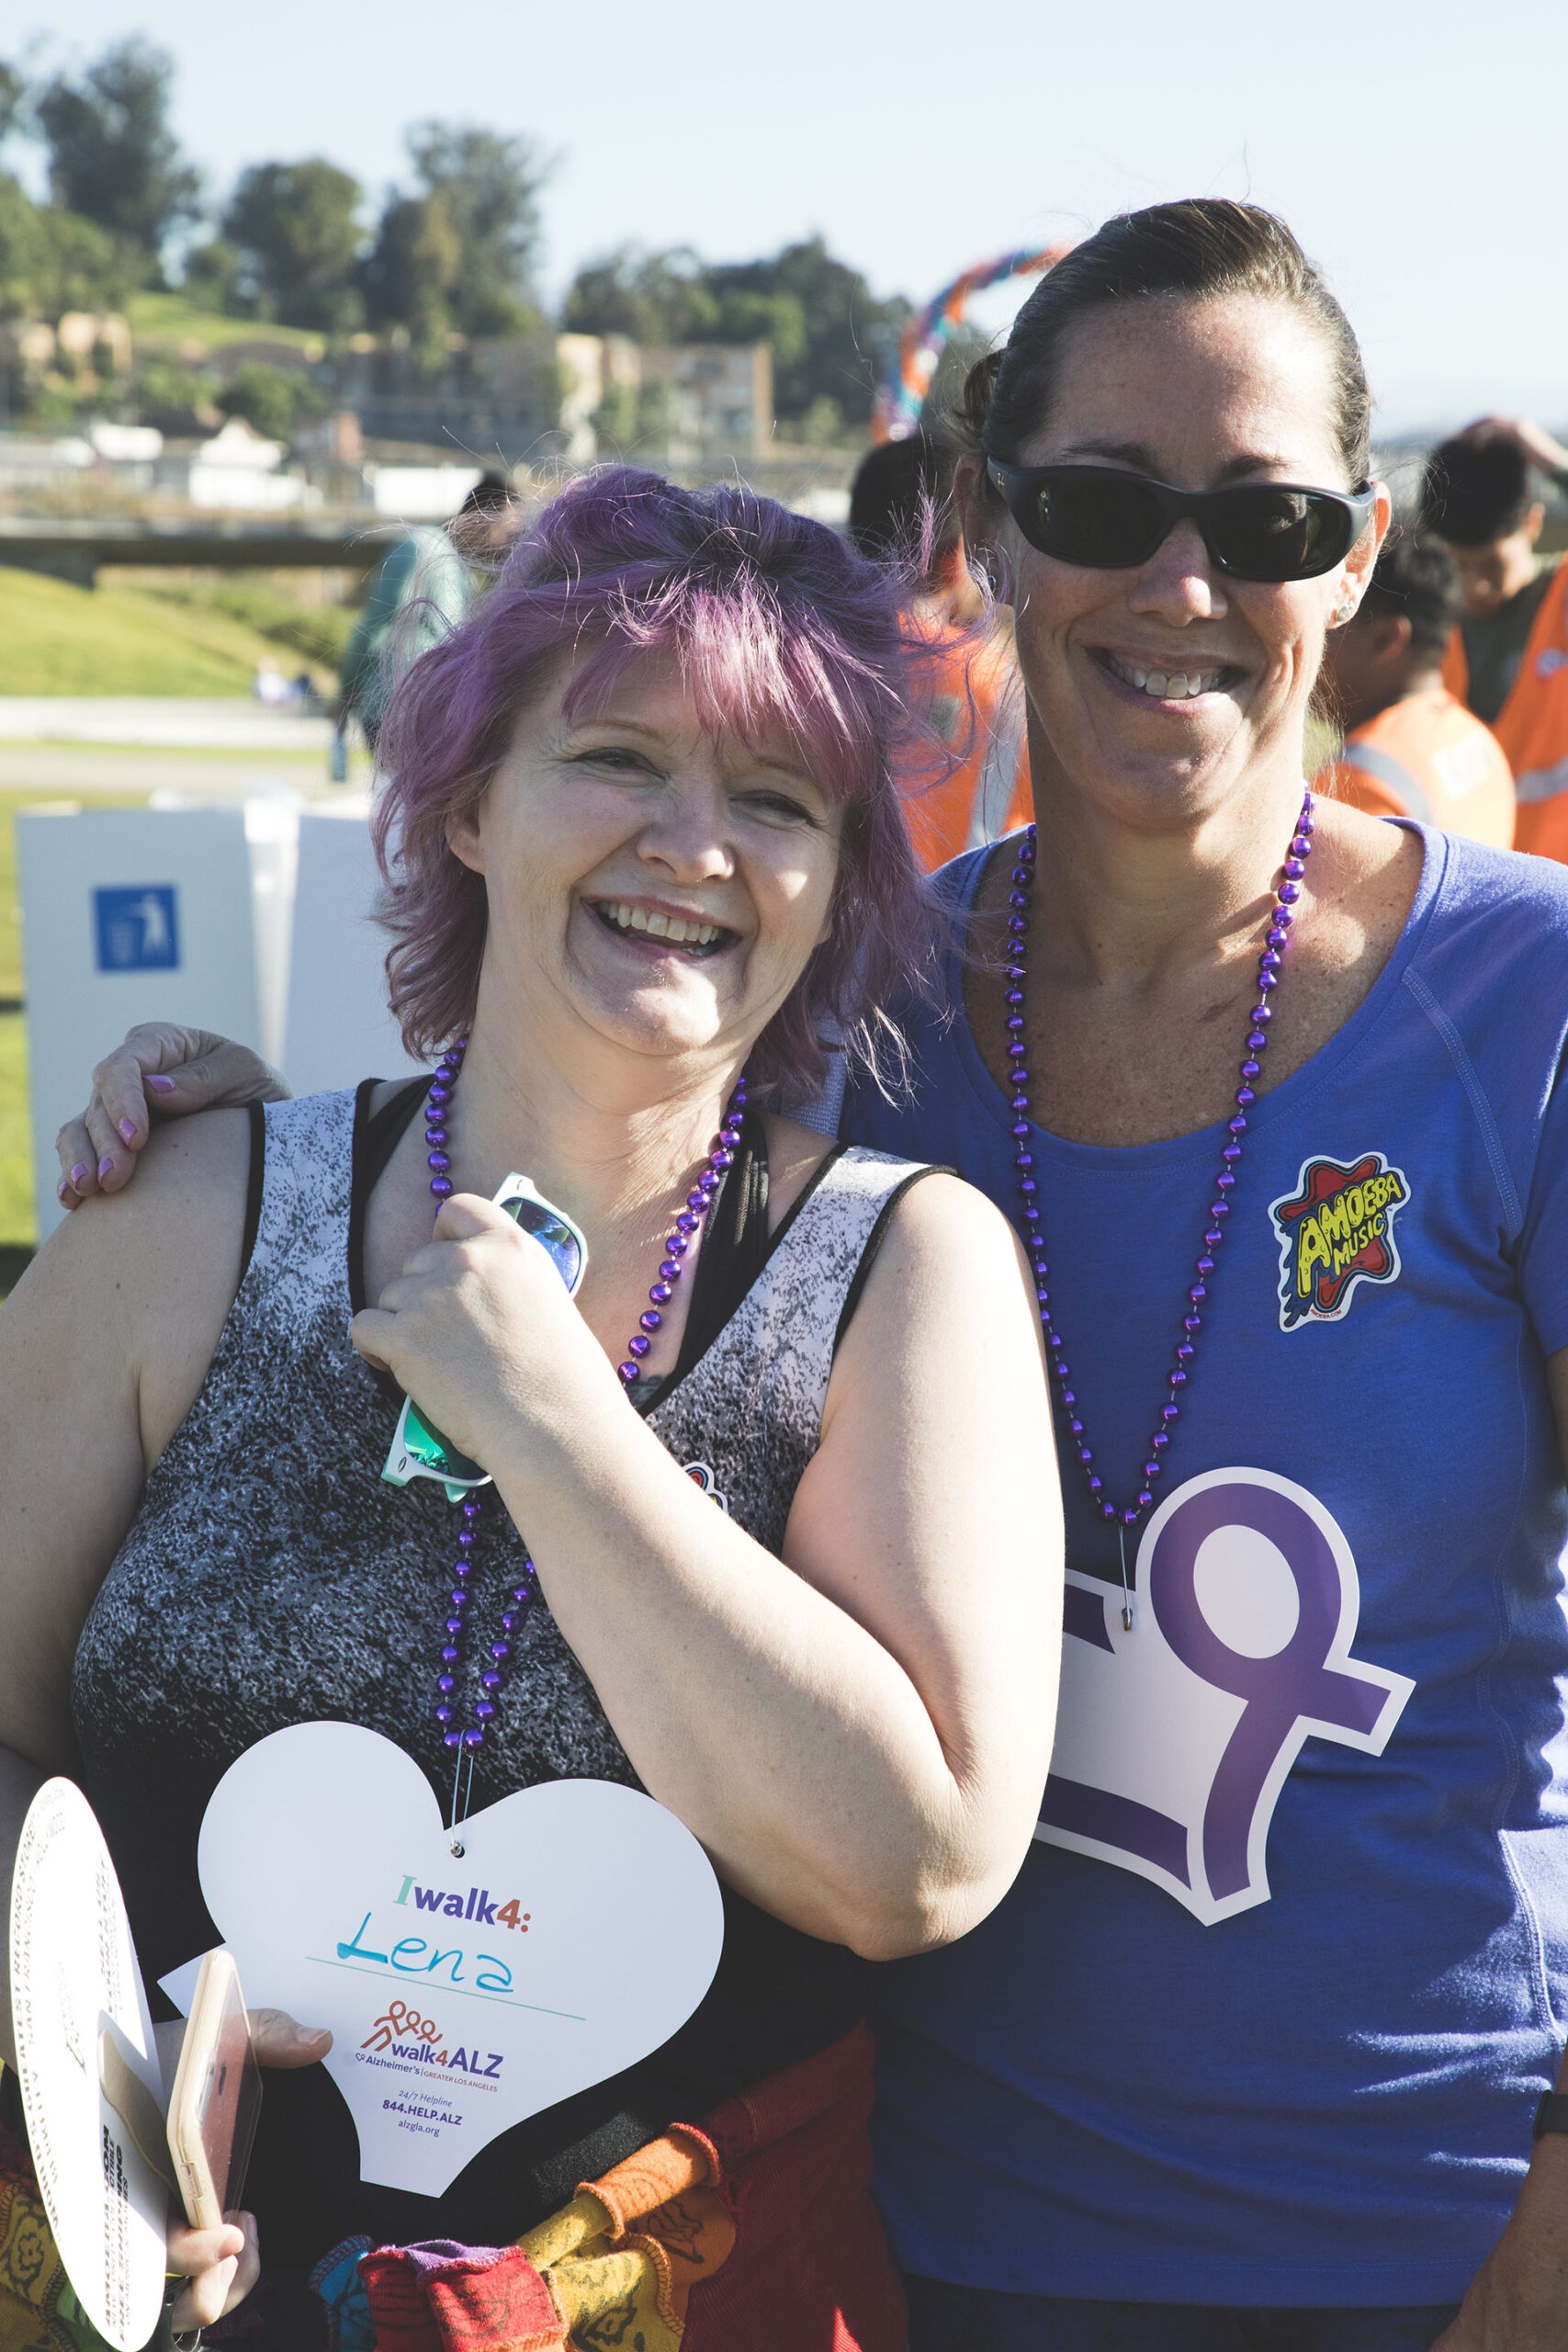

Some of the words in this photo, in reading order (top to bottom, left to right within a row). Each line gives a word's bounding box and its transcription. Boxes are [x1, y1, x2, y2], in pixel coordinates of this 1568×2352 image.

[1297, 1171, 1403, 1298] AMOEBA
[1334, 1213, 1385, 1276] MUSIC
[1310, 1308, 1342, 1319] AMOEBA.COM
[13, 1883, 23, 1975] RECORD
[336, 1911, 513, 1993] Lena
[391, 2041, 503, 2079] walk4ALZ
[423, 2071, 454, 2083] GREATER
[454, 2077, 467, 2086] LOS
[468, 2080, 498, 2092] ANGELES
[382, 2099, 463, 2126] 844.HELP.ALZ
[398, 2089, 418, 2100] 24/7
[419, 2093, 453, 2108] Helpline
[398, 2119, 440, 2138] alzgla.org
[103, 2124, 111, 2328] AMOEBA.COM
[116, 2143, 124, 2271] SHIPPING
